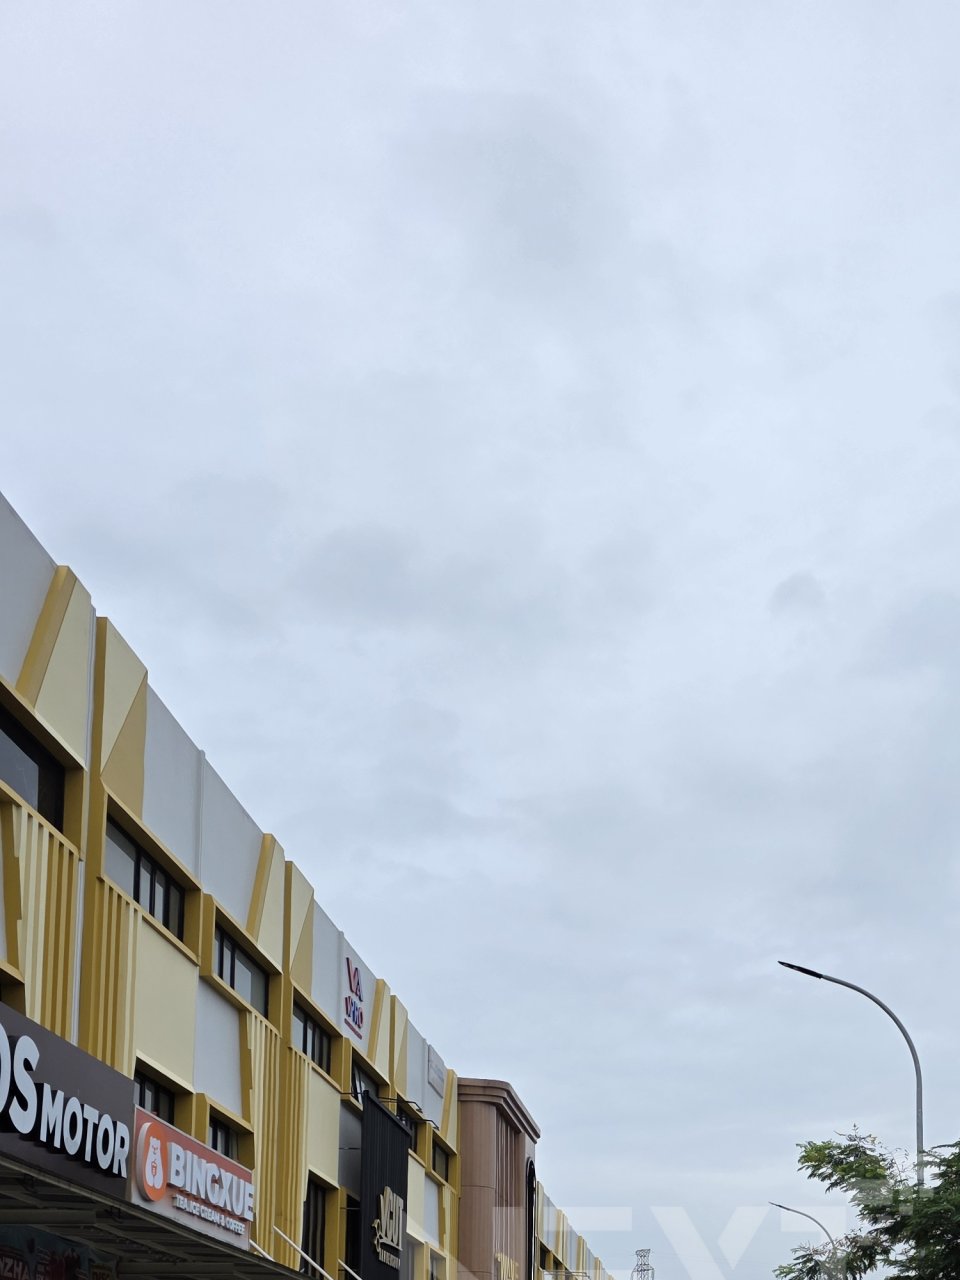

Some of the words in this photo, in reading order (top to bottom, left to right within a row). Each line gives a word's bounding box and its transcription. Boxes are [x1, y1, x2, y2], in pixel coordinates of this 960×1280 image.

[40, 1083, 130, 1179] MOTOR
[169, 1142, 254, 1222] BINGXUE
[200, 1205, 220, 1224] CREAM
[226, 1217, 246, 1236] COFFEE
